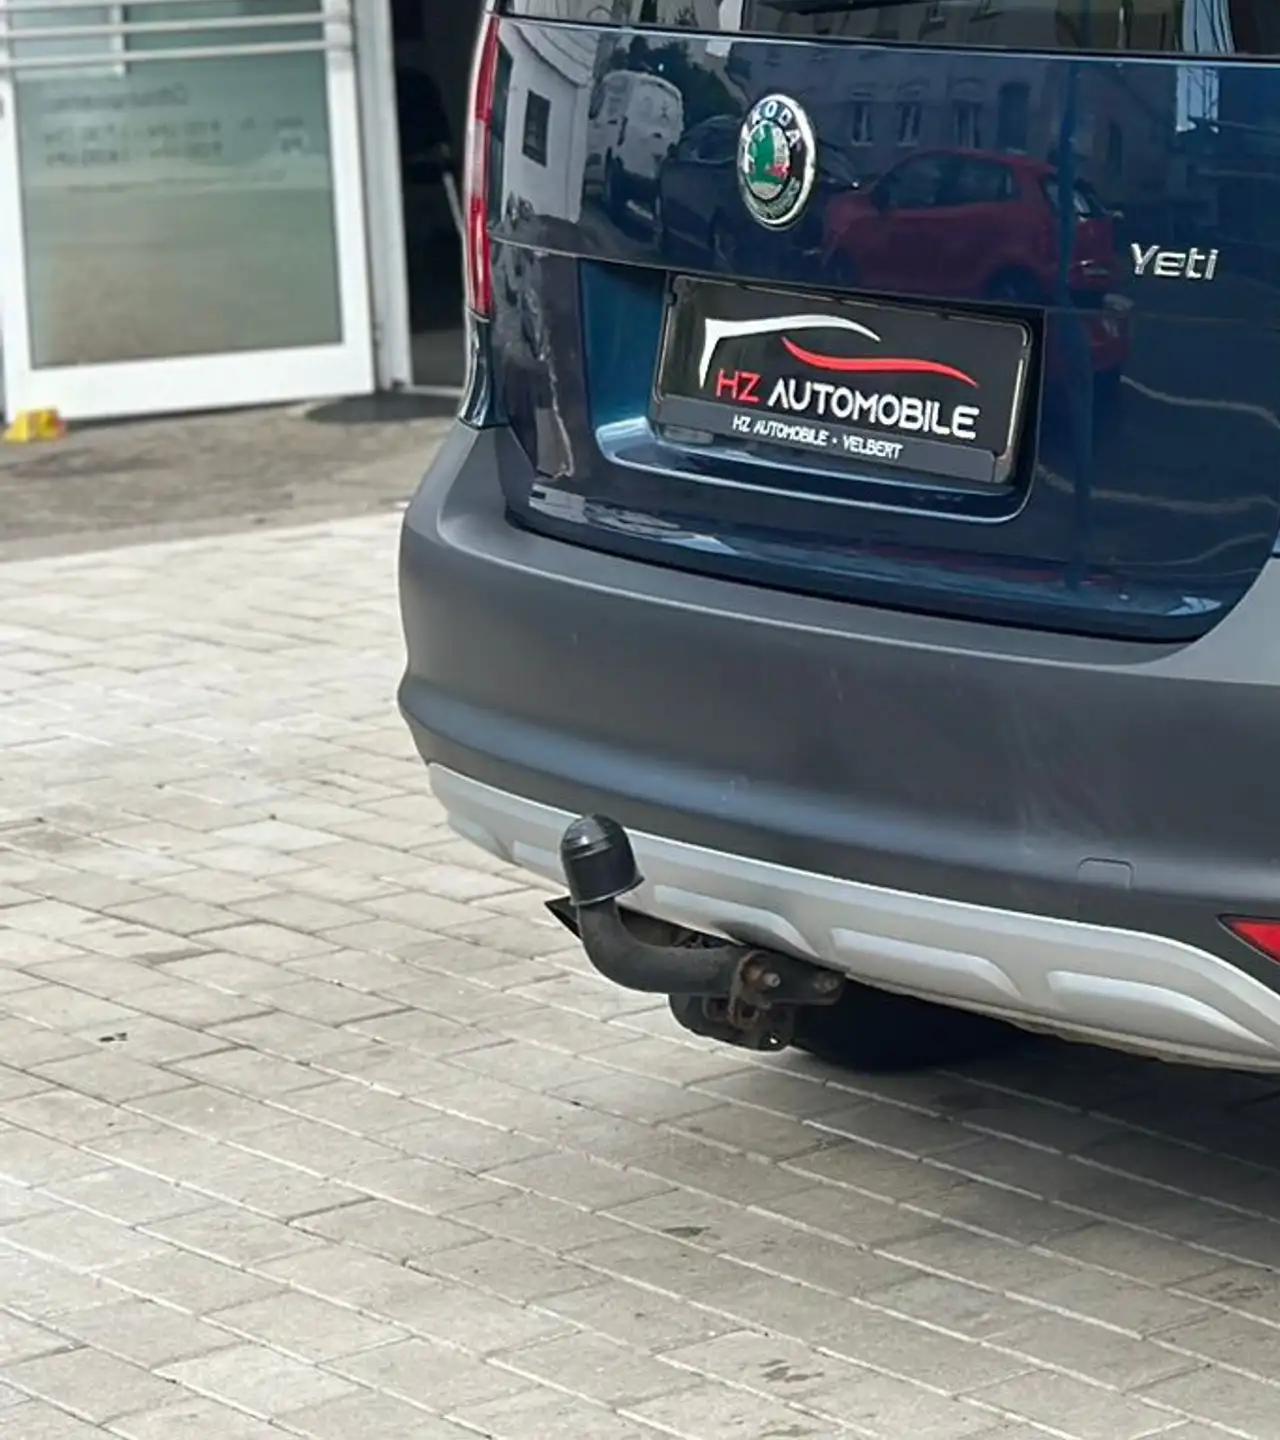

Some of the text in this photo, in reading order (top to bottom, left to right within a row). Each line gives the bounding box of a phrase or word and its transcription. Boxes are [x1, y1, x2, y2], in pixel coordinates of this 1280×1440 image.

[1130, 242, 1219, 280] Yeti
[715, 368, 980, 440] HZ AUTOMOBILE
[733, 414, 751, 432] HZ
[753, 420, 830, 447] AUTOMOBILE
